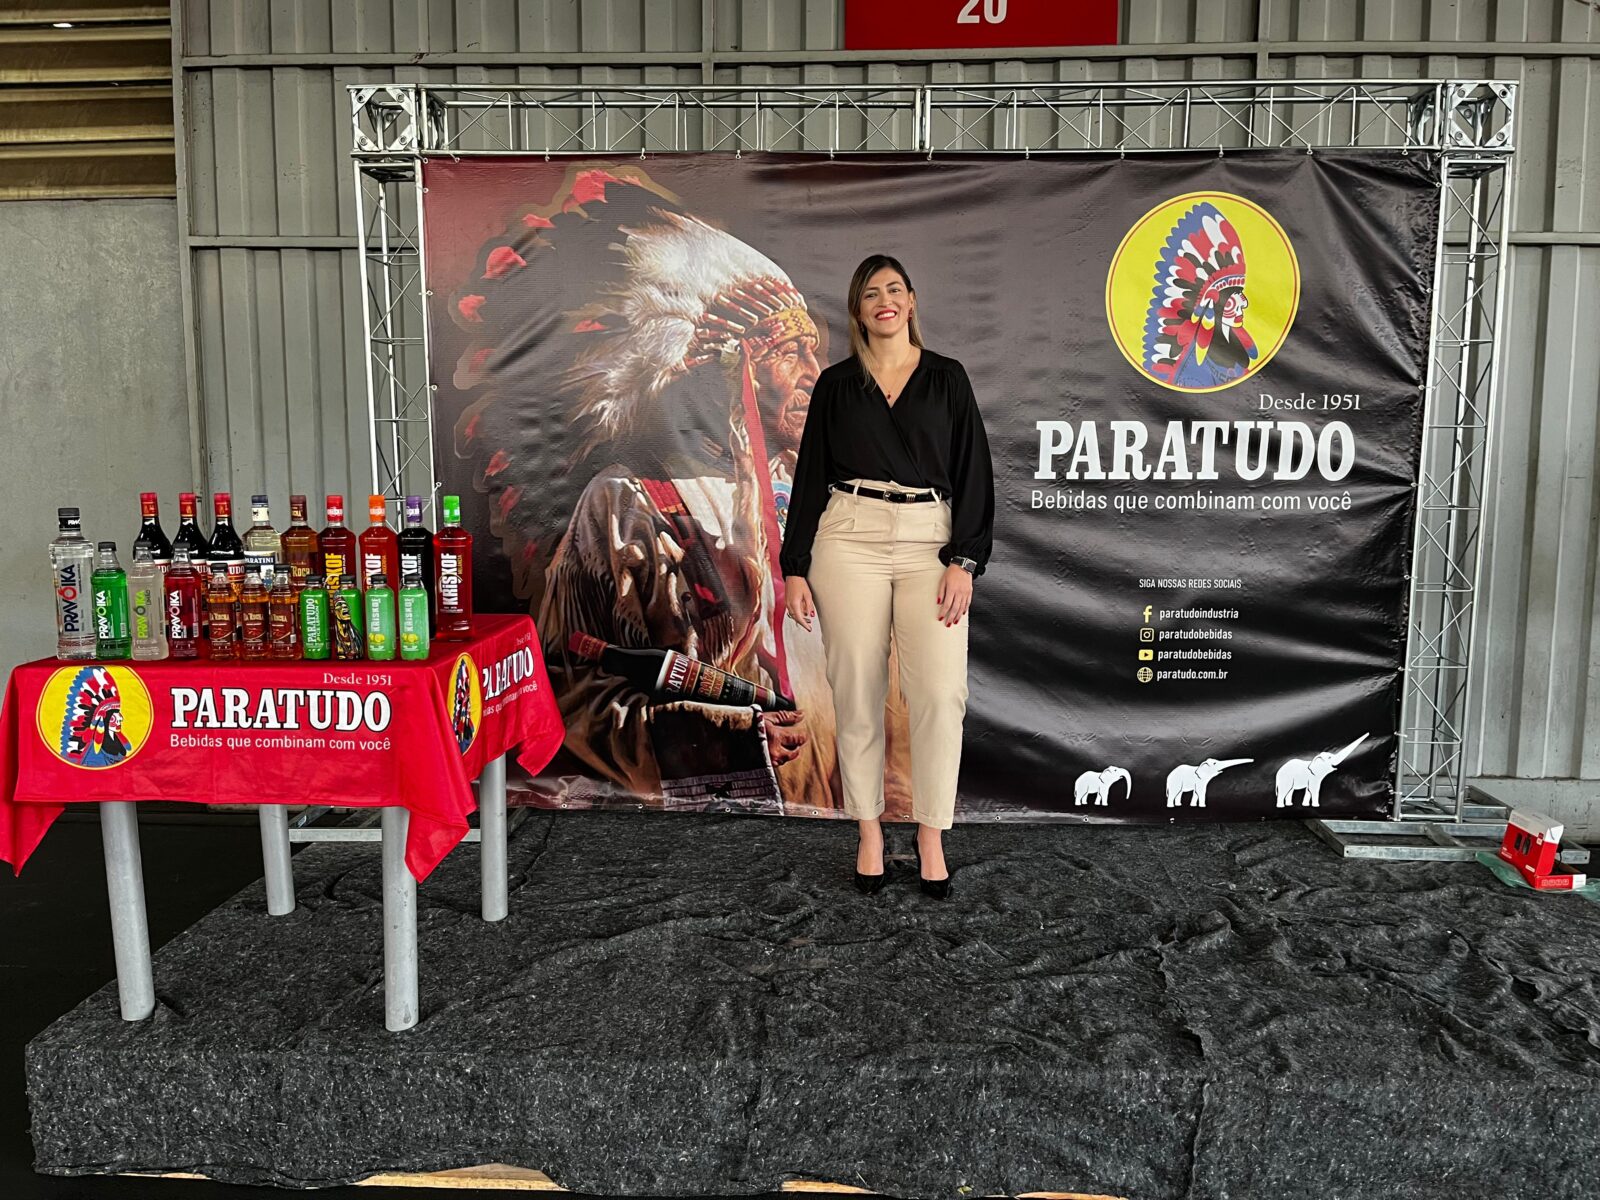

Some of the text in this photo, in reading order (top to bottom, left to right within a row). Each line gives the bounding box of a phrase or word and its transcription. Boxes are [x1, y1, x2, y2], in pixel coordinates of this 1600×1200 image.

[956, 0, 1008, 24] 20
[1258, 393, 1361, 411] Desde 1951
[1033, 420, 1356, 482] PARATUDO
[1031, 490, 1352, 513] Bebidas que combinam com você
[1139, 578, 1242, 589] SIGA NOSSAS REDES SOCIAIS
[306, 598, 317, 643] PARATUDO
[1159, 608, 1239, 621] paratudoindustria
[1158, 628, 1233, 642] paratudobebidas
[1157, 649, 1232, 662] paratudobebidas
[323, 672, 392, 686] Desde 1951
[1156, 669, 1228, 682] paratudo.com.br
[169, 687, 392, 733] PARATUDO
[170, 733, 391, 751] Bebidas que combinam com você
